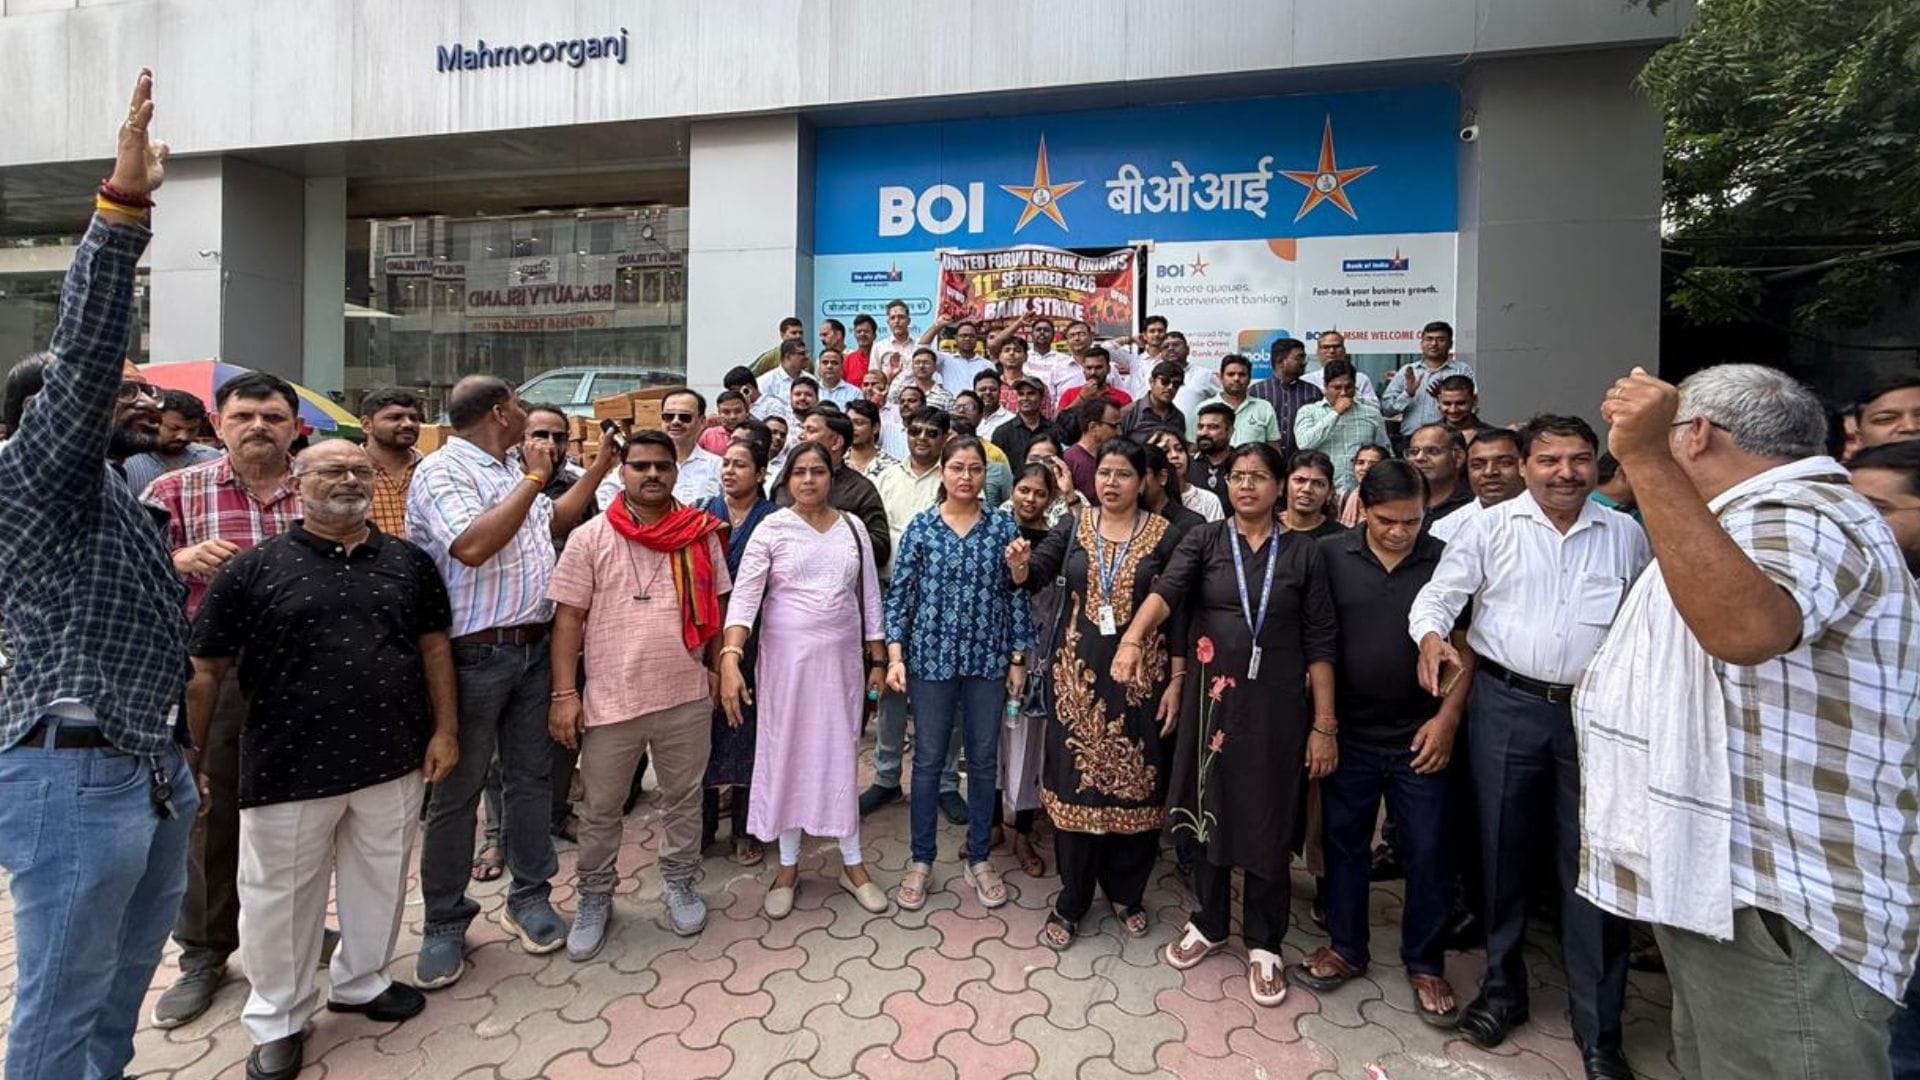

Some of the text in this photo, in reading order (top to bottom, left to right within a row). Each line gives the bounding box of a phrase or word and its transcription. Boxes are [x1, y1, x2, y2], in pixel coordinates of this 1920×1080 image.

[436, 28, 629, 72] Mahmoorganj
[1105, 156, 1273, 218] बीओआई
[878, 182, 984, 237] BOI
[943, 251, 1128, 271] UNITED FORUM OF BANK UNIONS
[1156, 264, 1184, 278] BOI
[1002, 270, 1063, 288] SEPTEMBER
[1065, 275, 1096, 292] 2026
[1156, 284, 1172, 294] No
[1312, 285, 1438, 296] Fast-track your business growth.
[984, 298, 1085, 321] BANK STRIKE
[1154, 297, 1175, 308] just
[1177, 296, 1239, 306] convenient
[1346, 300, 1371, 308] Switch
[1392, 300, 1401, 308] to
[1344, 331, 1368, 340] MSME
[1371, 331, 1413, 340] WELCOME
